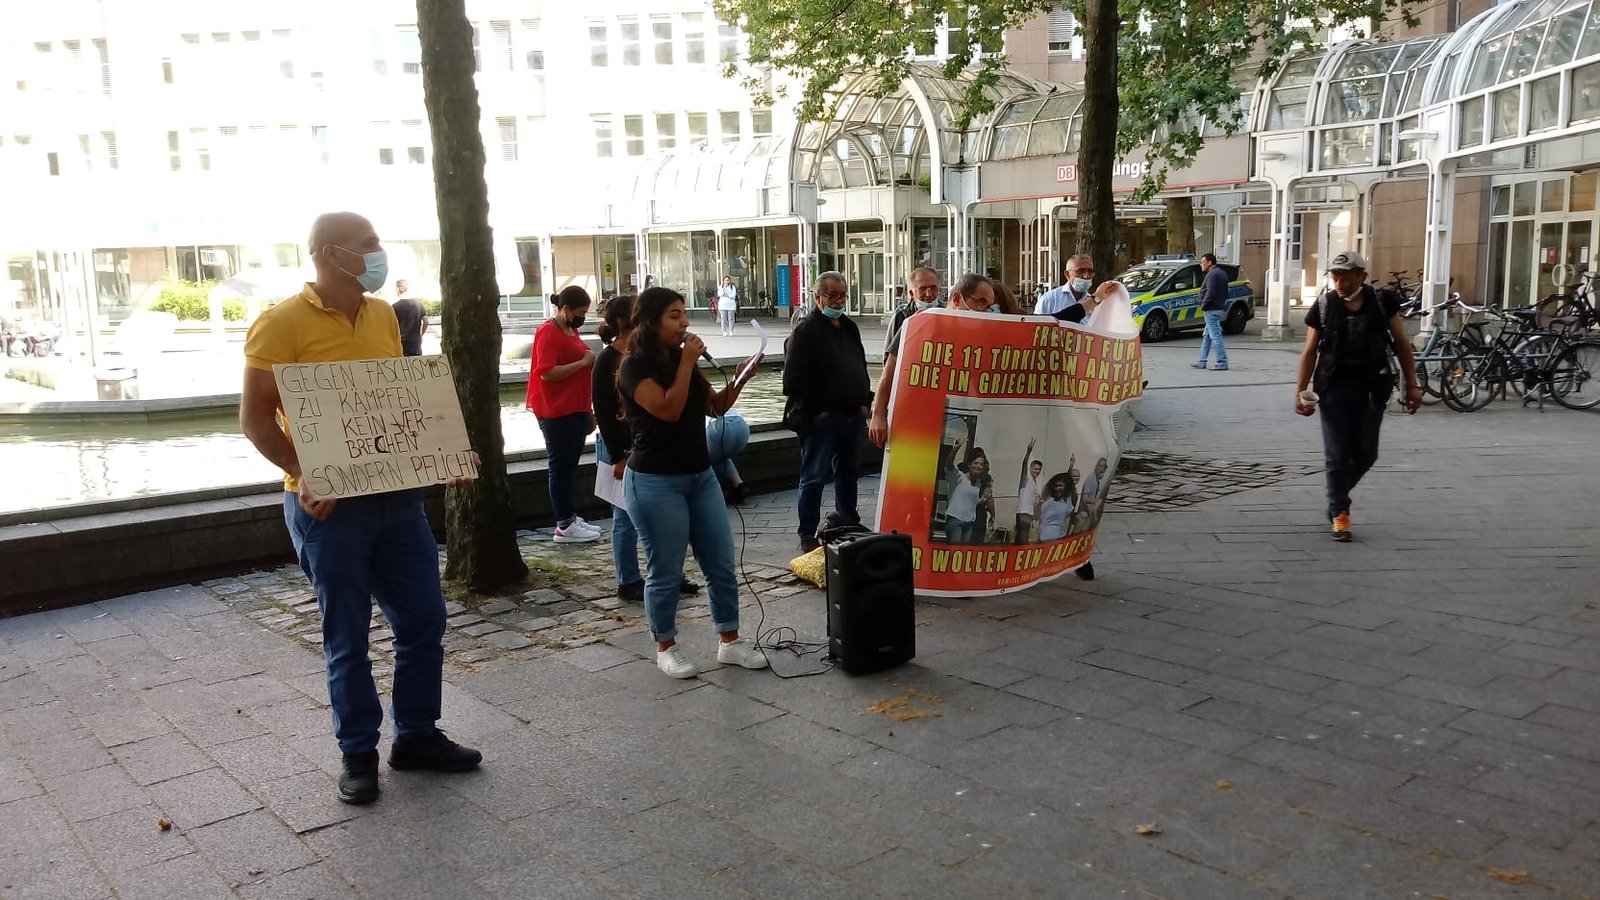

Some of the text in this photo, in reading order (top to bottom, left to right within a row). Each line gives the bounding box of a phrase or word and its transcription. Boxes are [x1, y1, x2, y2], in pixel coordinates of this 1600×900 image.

[1058, 160, 1150, 180] DB unge
[921, 340, 953, 367] DIE
[963, 346, 983, 369] 11
[1102, 337, 1137, 361] FÜR
[281, 356, 450, 393] GEGEN FASCHISMUS
[909, 364, 941, 389] DIE
[949, 370, 970, 392] IN
[1097, 379, 1142, 402] GEFA
[297, 385, 421, 419] ZU KÄMPFEN
[346, 431, 420, 459] BRECHEN
[311, 461, 404, 497] SONDERN
[932, 548, 1007, 573] WOLLEN
[1014, 548, 1042, 571] EIN
